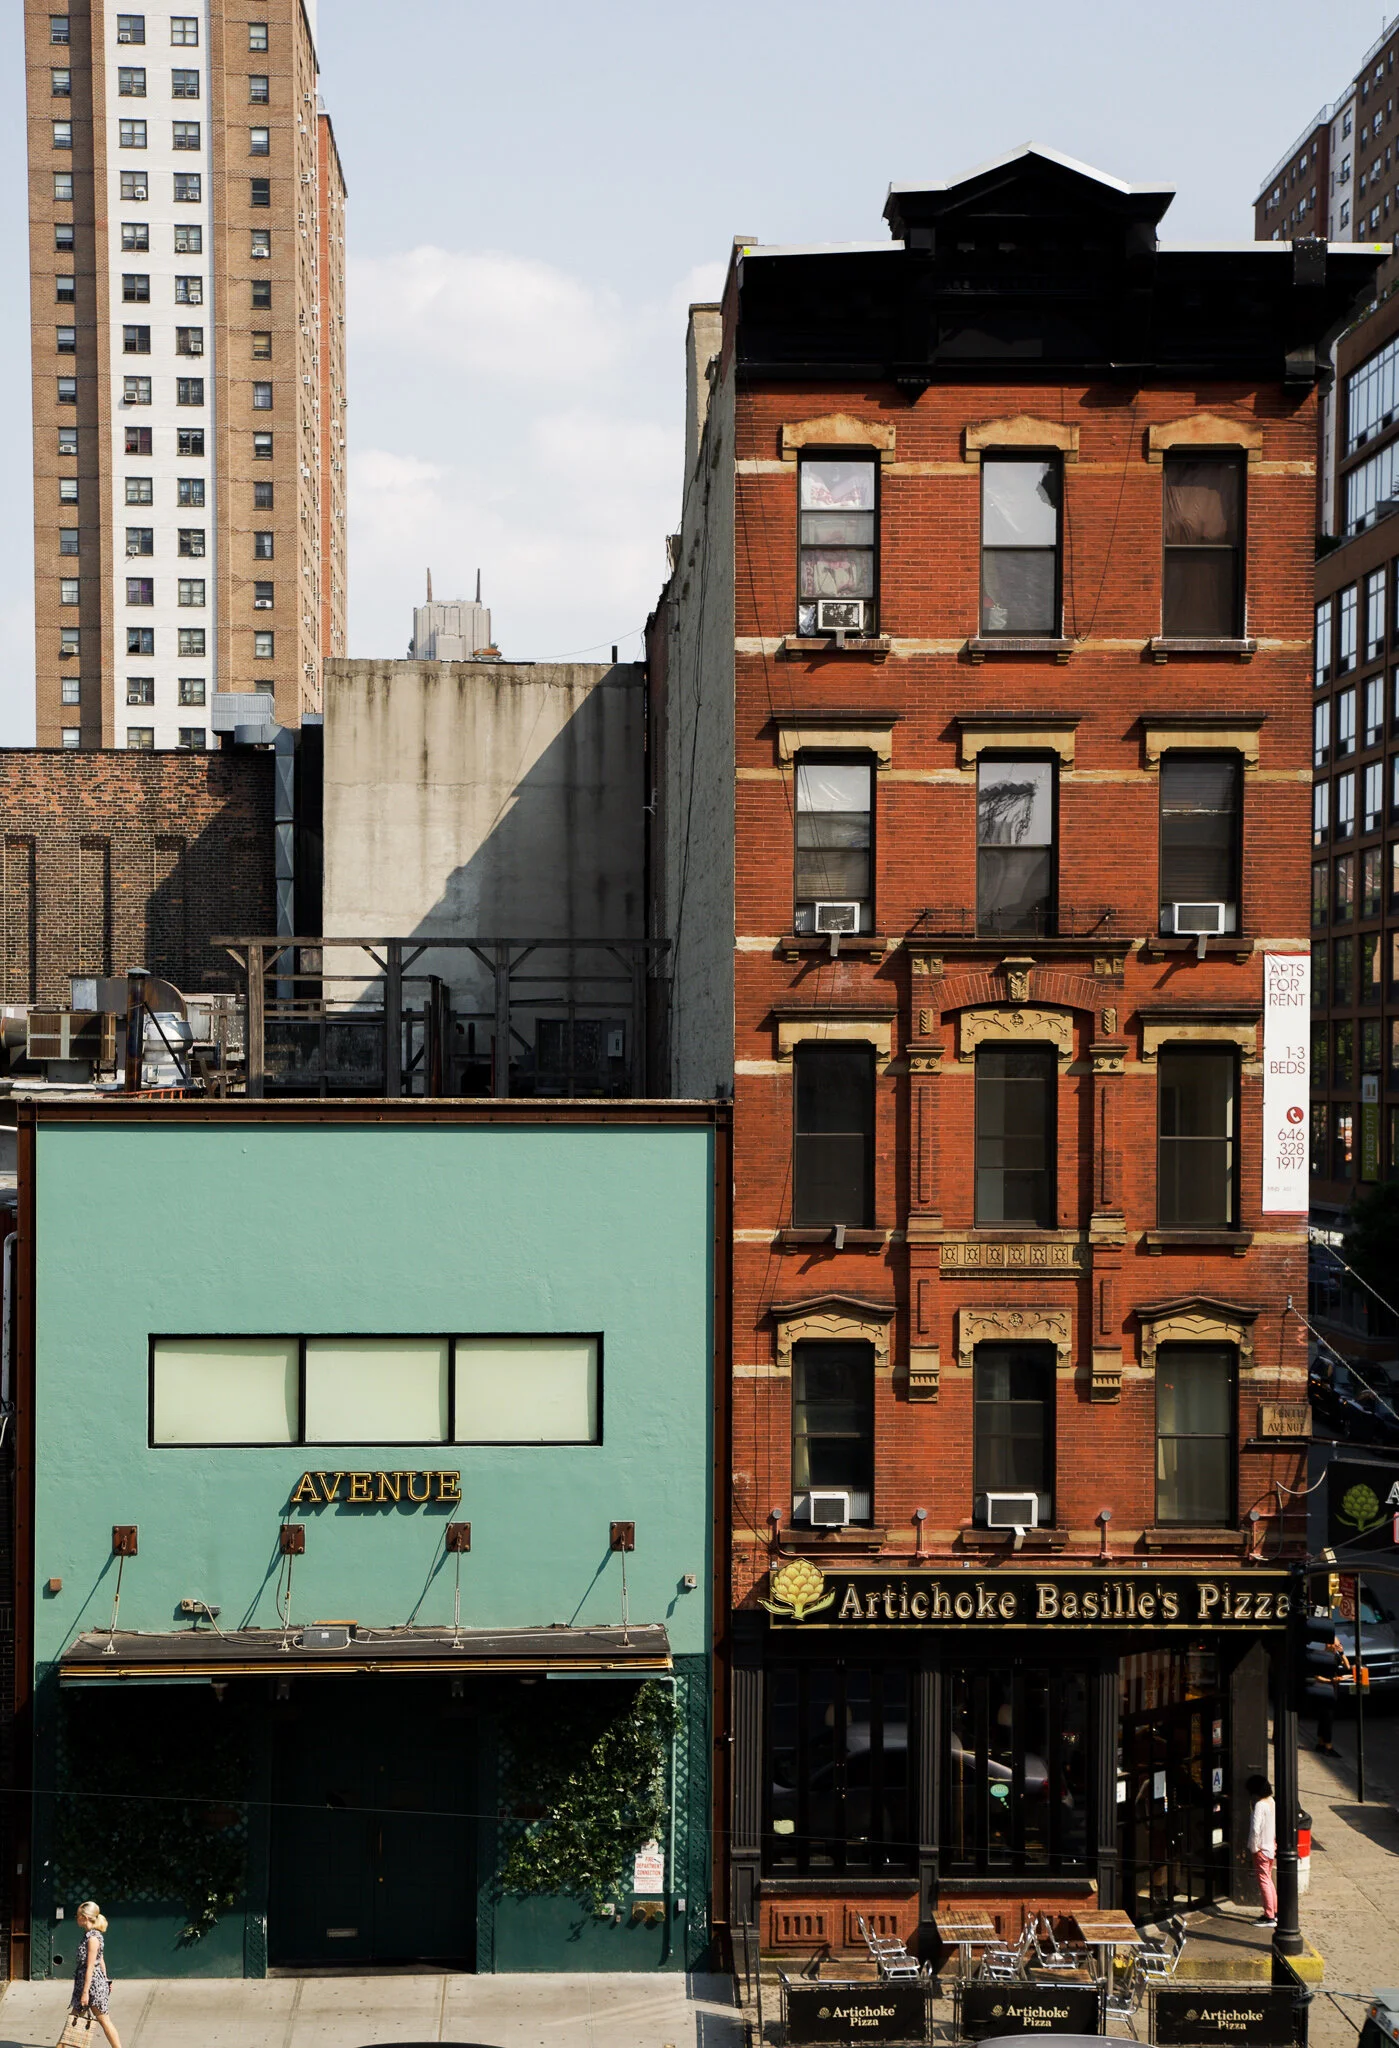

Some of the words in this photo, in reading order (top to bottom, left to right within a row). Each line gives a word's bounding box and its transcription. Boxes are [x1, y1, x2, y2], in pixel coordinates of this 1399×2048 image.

[1269, 964, 1305, 977] APTS
[1269, 978, 1299, 991] FOR
[1269, 993, 1305, 1006] RENT
[1285, 1046, 1305, 1060] 1-3
[1270, 1061, 1305, 1074] BEDS
[1277, 1128, 1305, 1141] 646
[1279, 1142, 1305, 1156] 328
[1275, 1157, 1304, 1170] 1917
[1268, 1423, 1304, 1432] AVENUE
[290, 1471, 462, 1503] AVENUE
[838, 1582, 1017, 1620] Artichoke
[1035, 1582, 1179, 1620] Basille's
[1196, 1582, 1291, 1620] Pizza
[850, 2016, 879, 2027] Pizza
[1023, 2016, 1052, 2027] Pizza
[1218, 2020, 1246, 2030] Pizza
